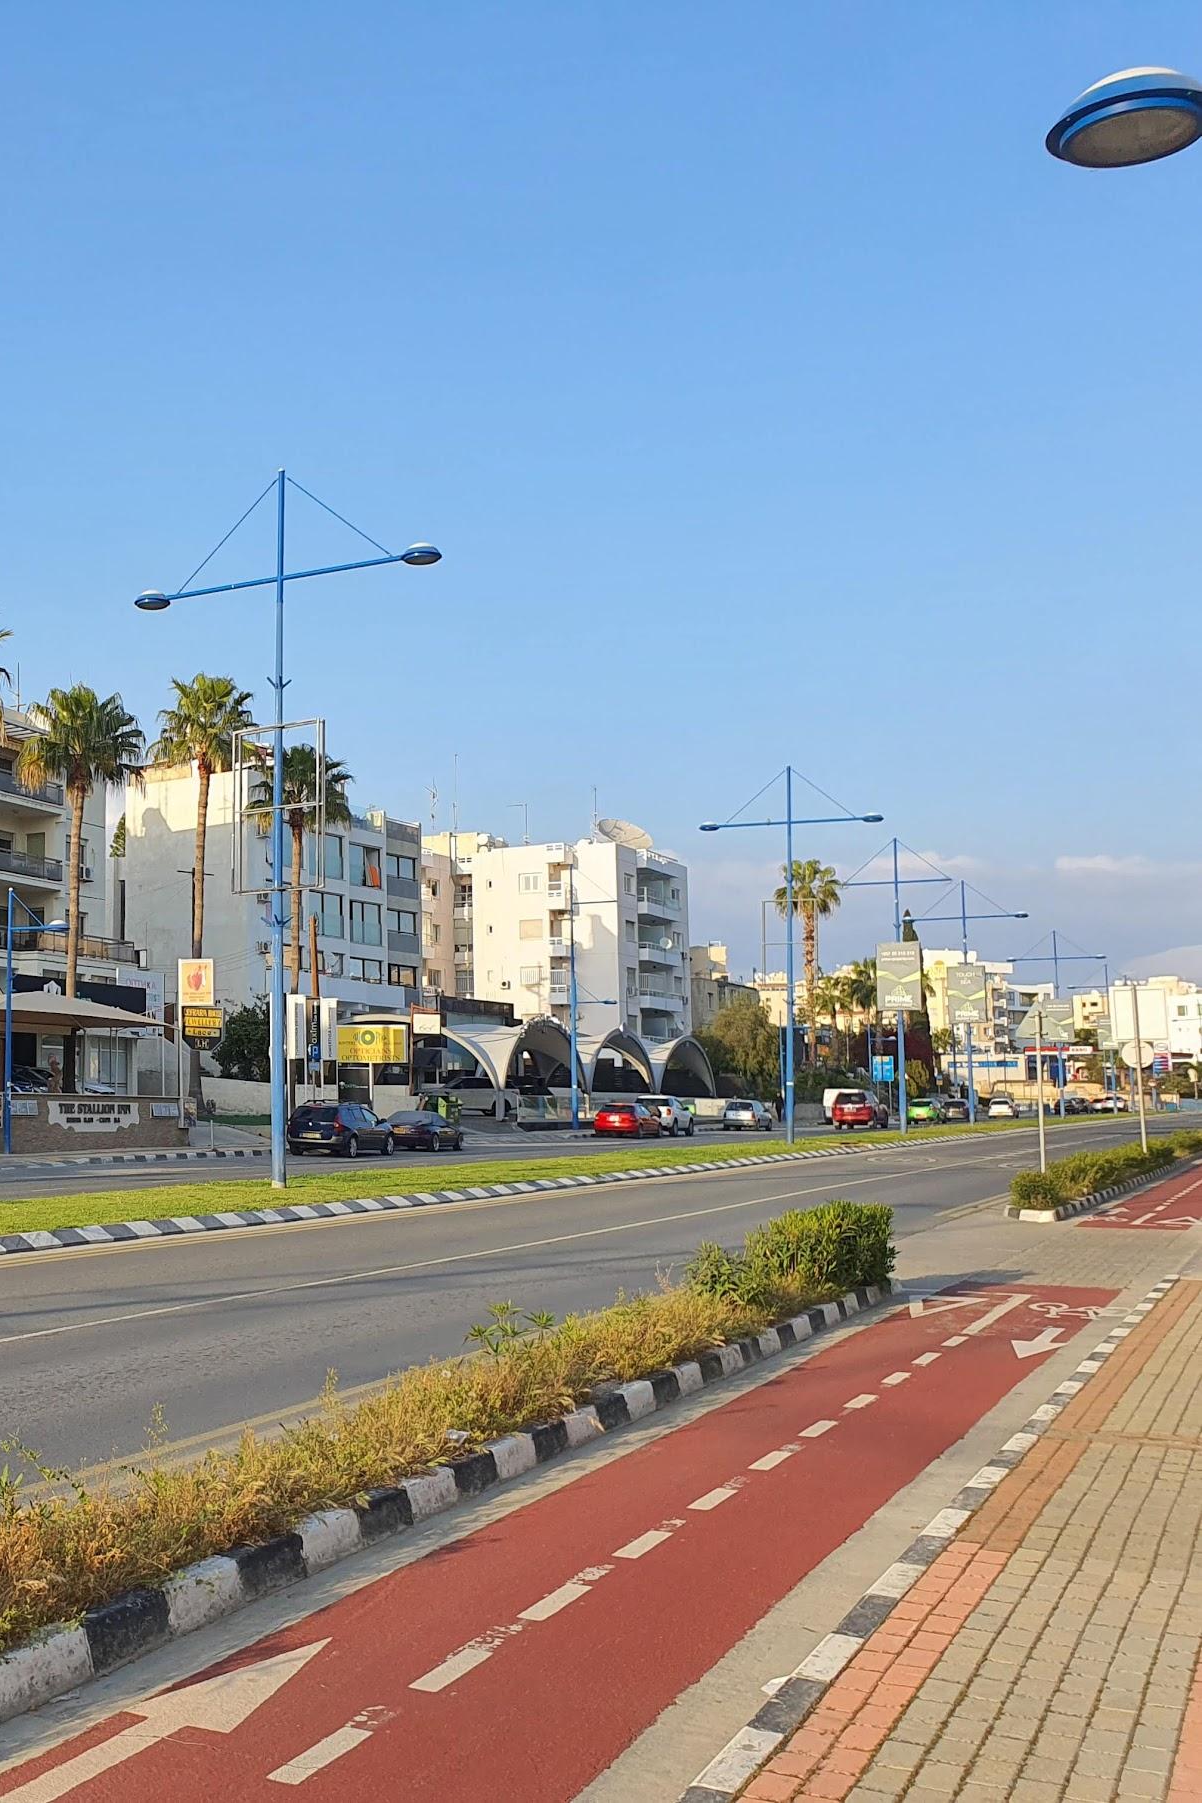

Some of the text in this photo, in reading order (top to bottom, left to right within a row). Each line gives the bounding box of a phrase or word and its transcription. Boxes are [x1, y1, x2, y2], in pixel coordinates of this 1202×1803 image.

[884, 994, 913, 1003] PRIME
[59, 1103, 131, 1114] THE STALLION INN
